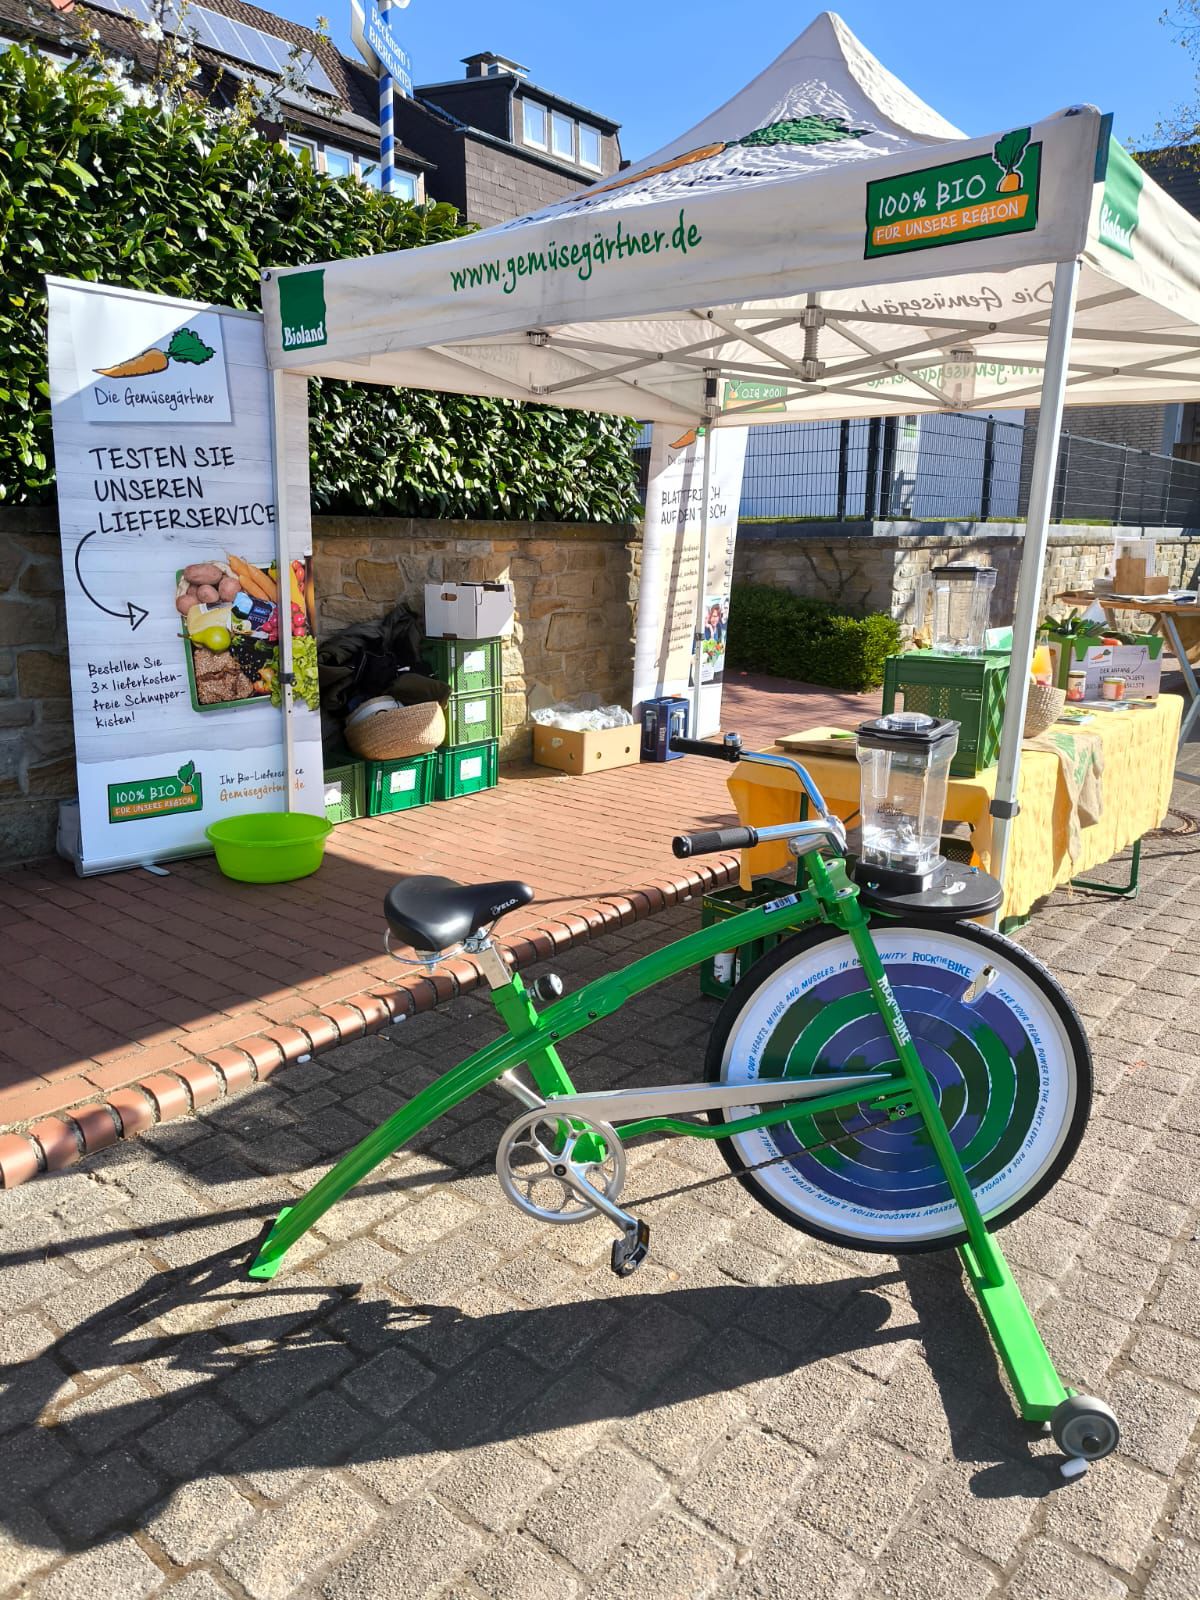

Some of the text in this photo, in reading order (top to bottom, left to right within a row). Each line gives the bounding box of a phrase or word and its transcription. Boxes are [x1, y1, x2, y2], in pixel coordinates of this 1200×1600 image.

[879, 174, 986, 219] 100% BIO
[876, 200, 1019, 241] FÜR UNSERE REGION
[450, 208, 702, 294] www.gemüsegärtner.de
[283, 322, 324, 346] Bioland
[94, 387, 215, 411] Die Gemüsegärtner
[89, 445, 235, 470] TESTEN SIE
[94, 476, 204, 502] UNSEREN
[98, 503, 276, 535] LIEFERSERVICE
[87, 657, 163, 677] Bestellen Sie
[112, 674, 183, 691] lieferkosten-
[92, 691, 187, 712] freie Schnupper-
[96, 716, 136, 729] kisten!
[116, 784, 176, 804] 100% BIO
[839, 961, 849, 970] IN
[786, 986, 800, 1002] AND
[995, 989, 1015, 1004] TAKE
[1013, 1003, 1029, 1021] YOUR
[1026, 1023, 1042, 1045] PEDAL
[748, 1055, 756, 1072] OUR
[1038, 1048, 1048, 1074] POWER
[1042, 1077, 1050, 1086] TO
[1041, 1088, 1049, 1103] THE
[1035, 1105, 1046, 1127] NEXT
[782, 1166, 791, 1174] IS
[1013, 1152, 1026, 1169] RIDE
[790, 1174, 815, 1194] FUTURE
[980, 1173, 1007, 1194] BICYCLE
[816, 1193, 840, 1207] GREEN
